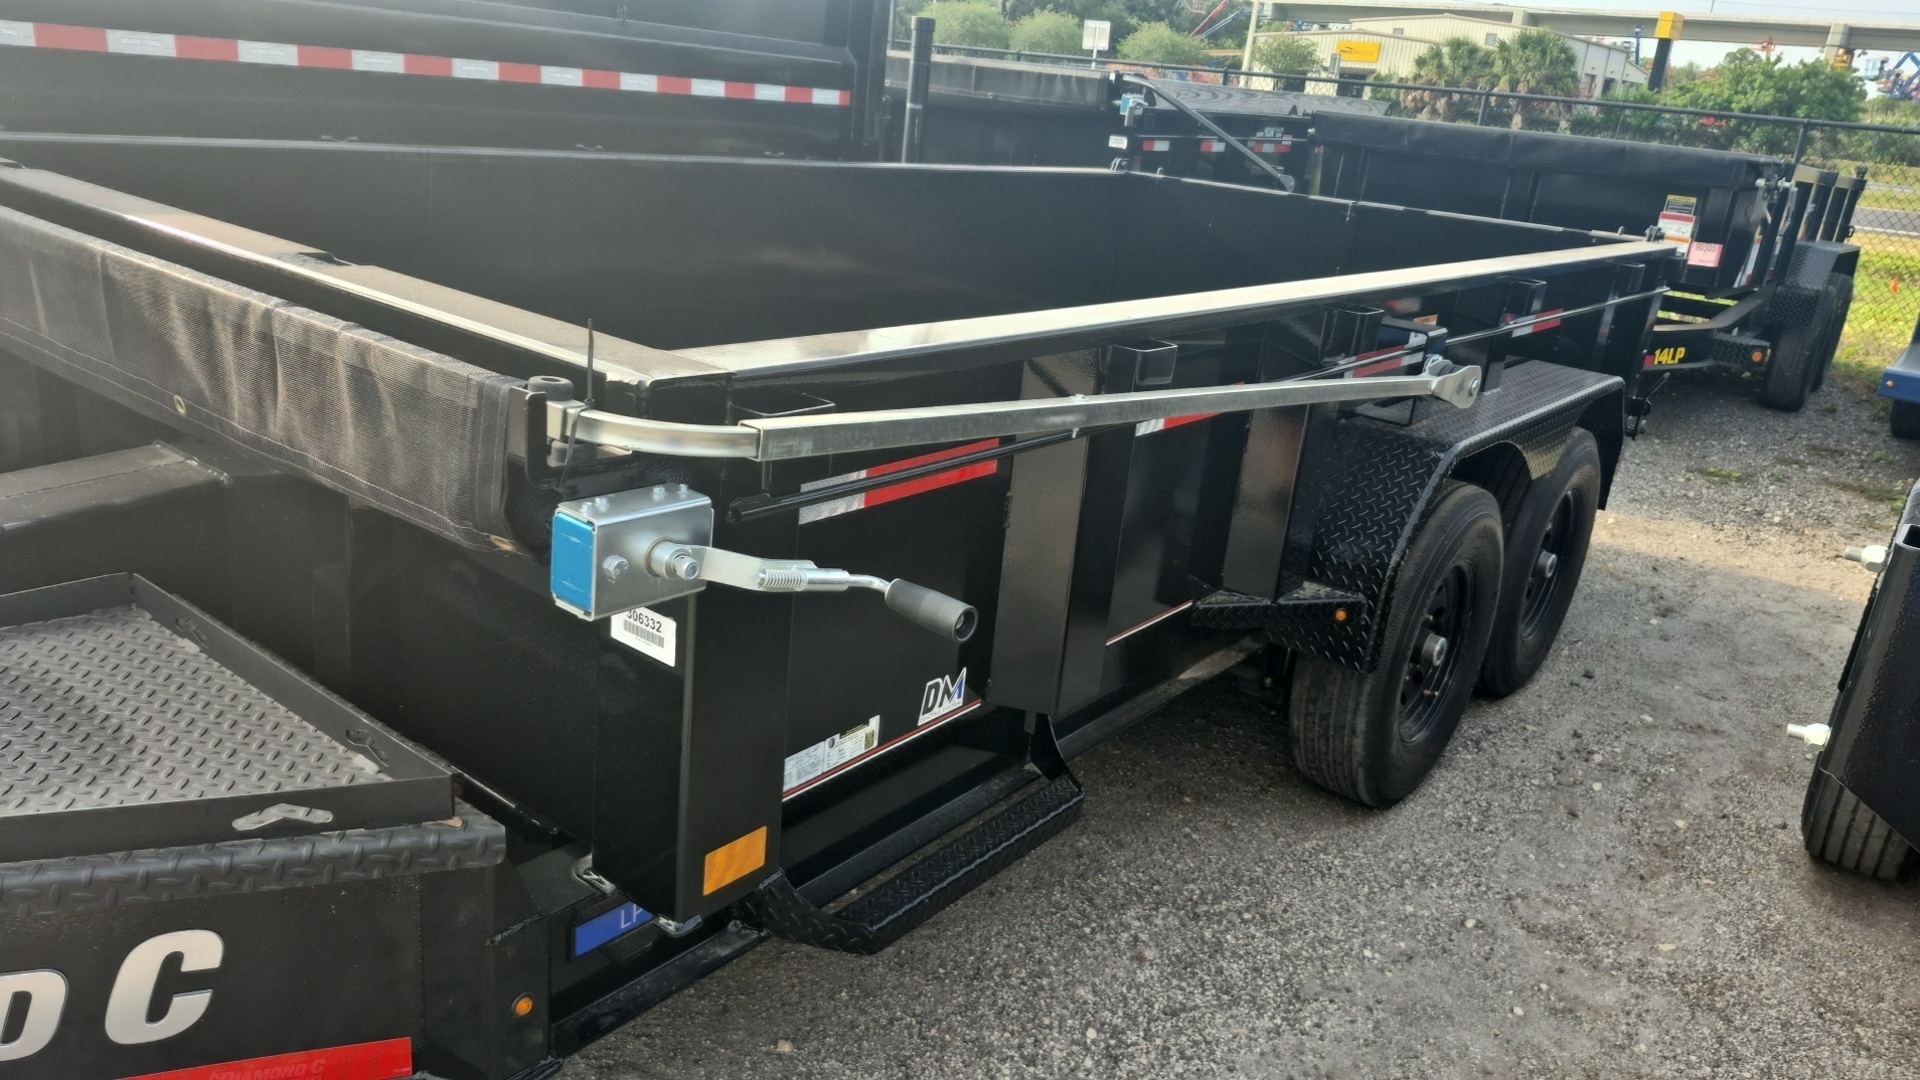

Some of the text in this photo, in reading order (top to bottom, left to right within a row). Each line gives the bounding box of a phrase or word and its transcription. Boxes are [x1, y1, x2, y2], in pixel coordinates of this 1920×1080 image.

[1653, 347, 1686, 365] 14LP
[627, 609, 662, 633] 306332
[104, 929, 224, 1045] C
[311, 1058, 326, 1074] C
